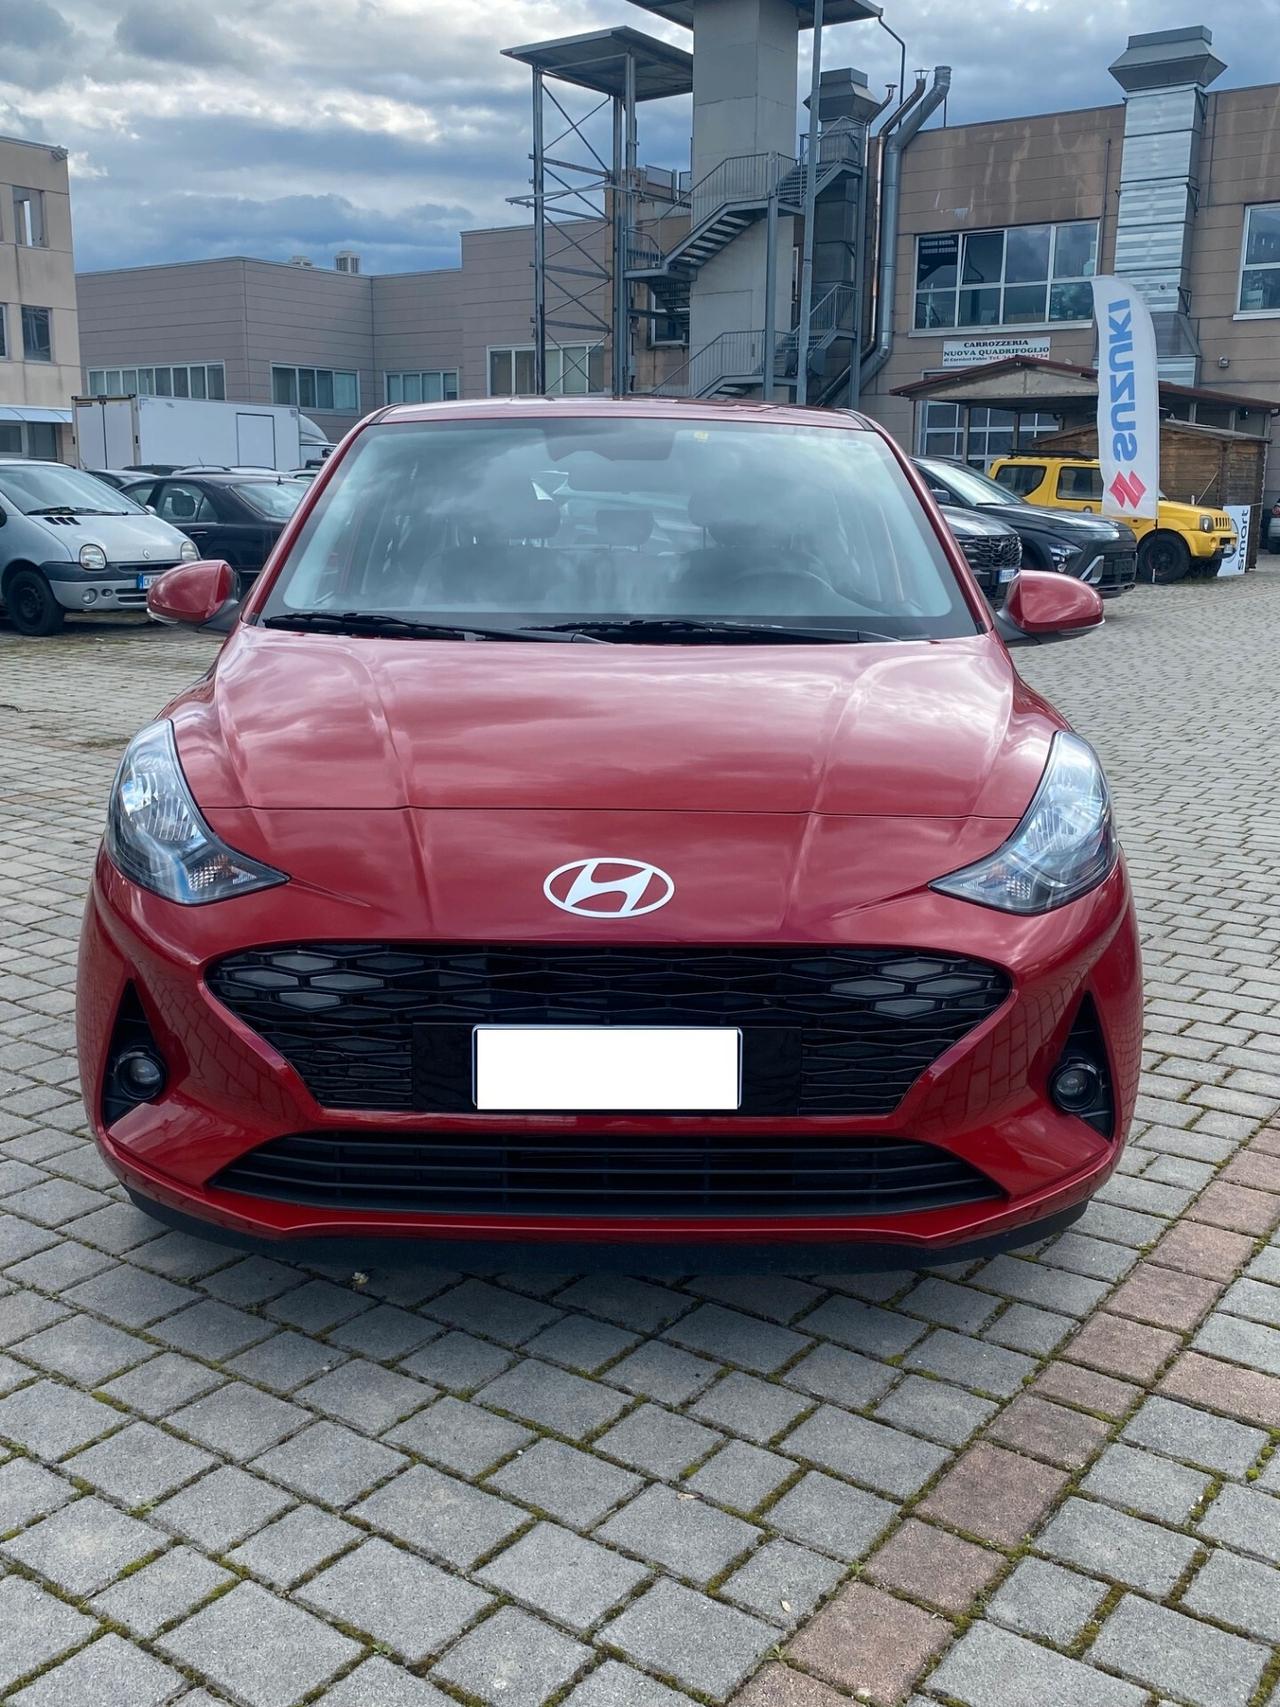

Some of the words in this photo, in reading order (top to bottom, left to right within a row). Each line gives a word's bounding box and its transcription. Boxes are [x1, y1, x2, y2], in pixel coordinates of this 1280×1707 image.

[963, 340, 1029, 348] CARROZZERIA
[978, 346, 1050, 356] QUADRIFOGLIO
[1237, 509, 1249, 570] smart
